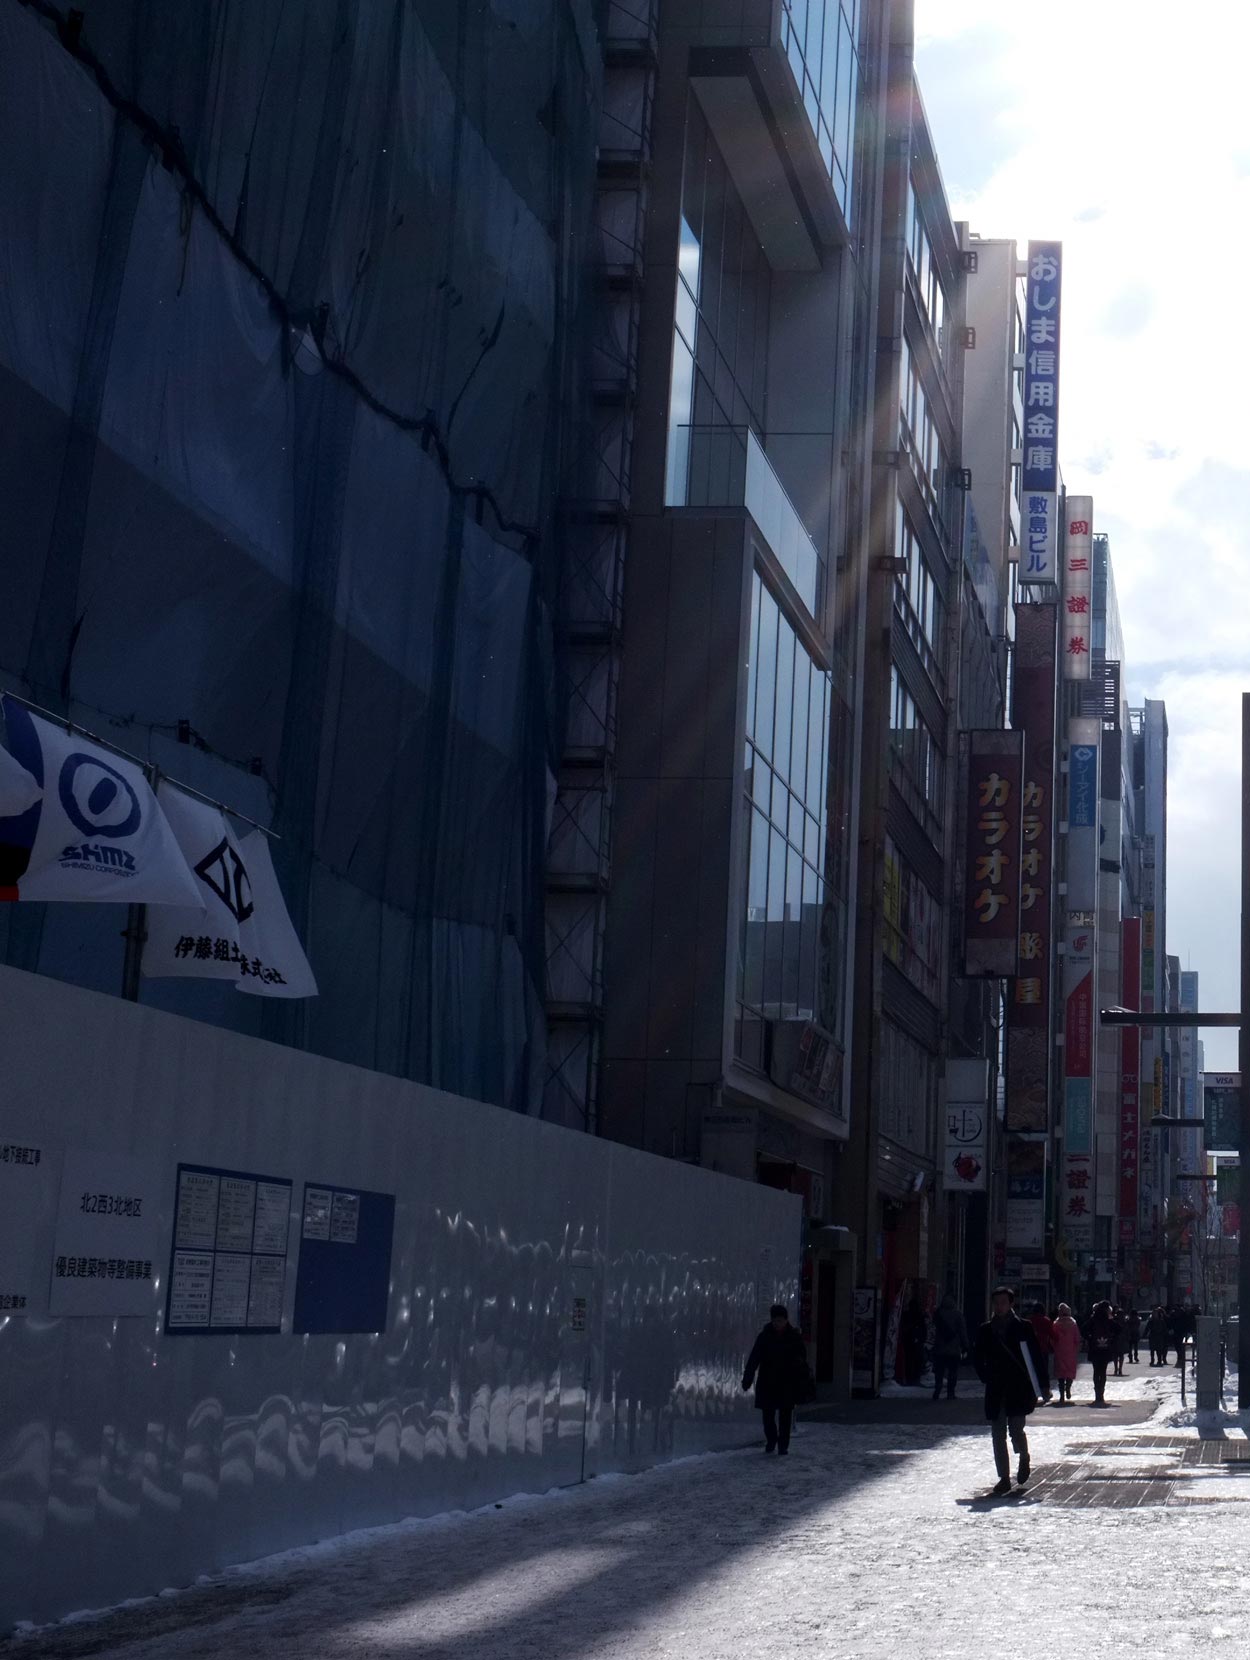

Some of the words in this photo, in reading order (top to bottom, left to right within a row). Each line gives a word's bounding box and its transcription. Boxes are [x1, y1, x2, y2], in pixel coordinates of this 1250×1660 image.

[1026, 254, 1058, 472] おしま信用金庫
[1027, 496, 1049, 573] 敷島ビル
[975, 772, 1011, 923] カラオケ
[1020, 781, 1045, 911] カラオケ
[1215, 1077, 1234, 1085] VISA
[80, 1192, 143, 1217] 北2西3北地区
[55, 1256, 152, 1279] 優良建築物等整備事業
